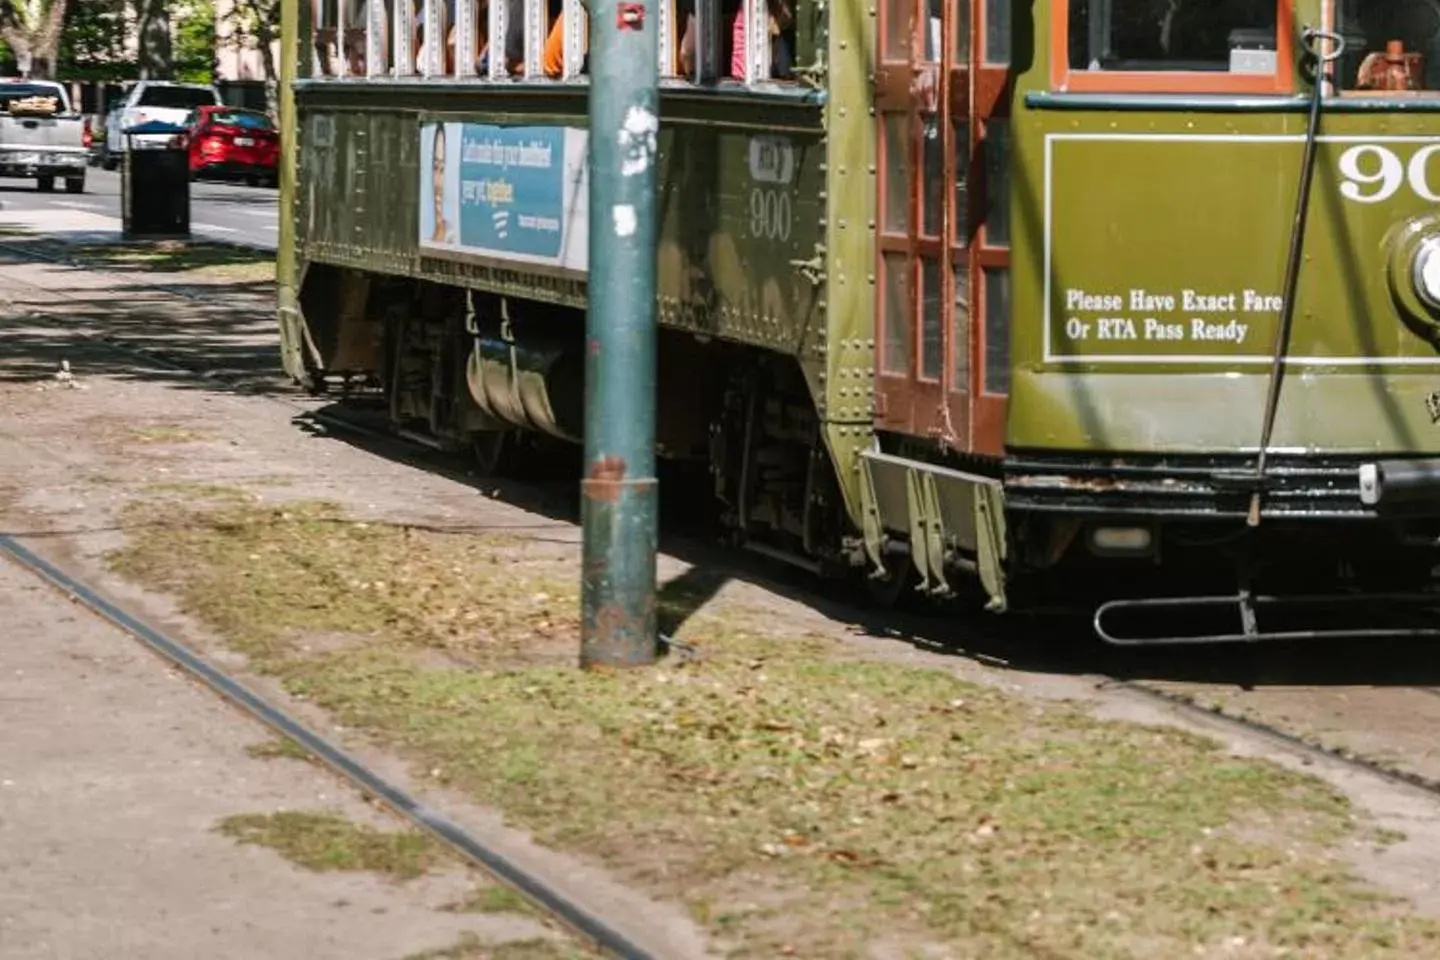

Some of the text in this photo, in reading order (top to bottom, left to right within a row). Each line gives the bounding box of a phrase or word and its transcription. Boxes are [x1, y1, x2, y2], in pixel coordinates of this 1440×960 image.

[751, 188, 791, 242] 900
[1066, 289, 1283, 312] Please Have Exact Fare
[1066, 318, 1249, 343] Or RTA Pass Ready
